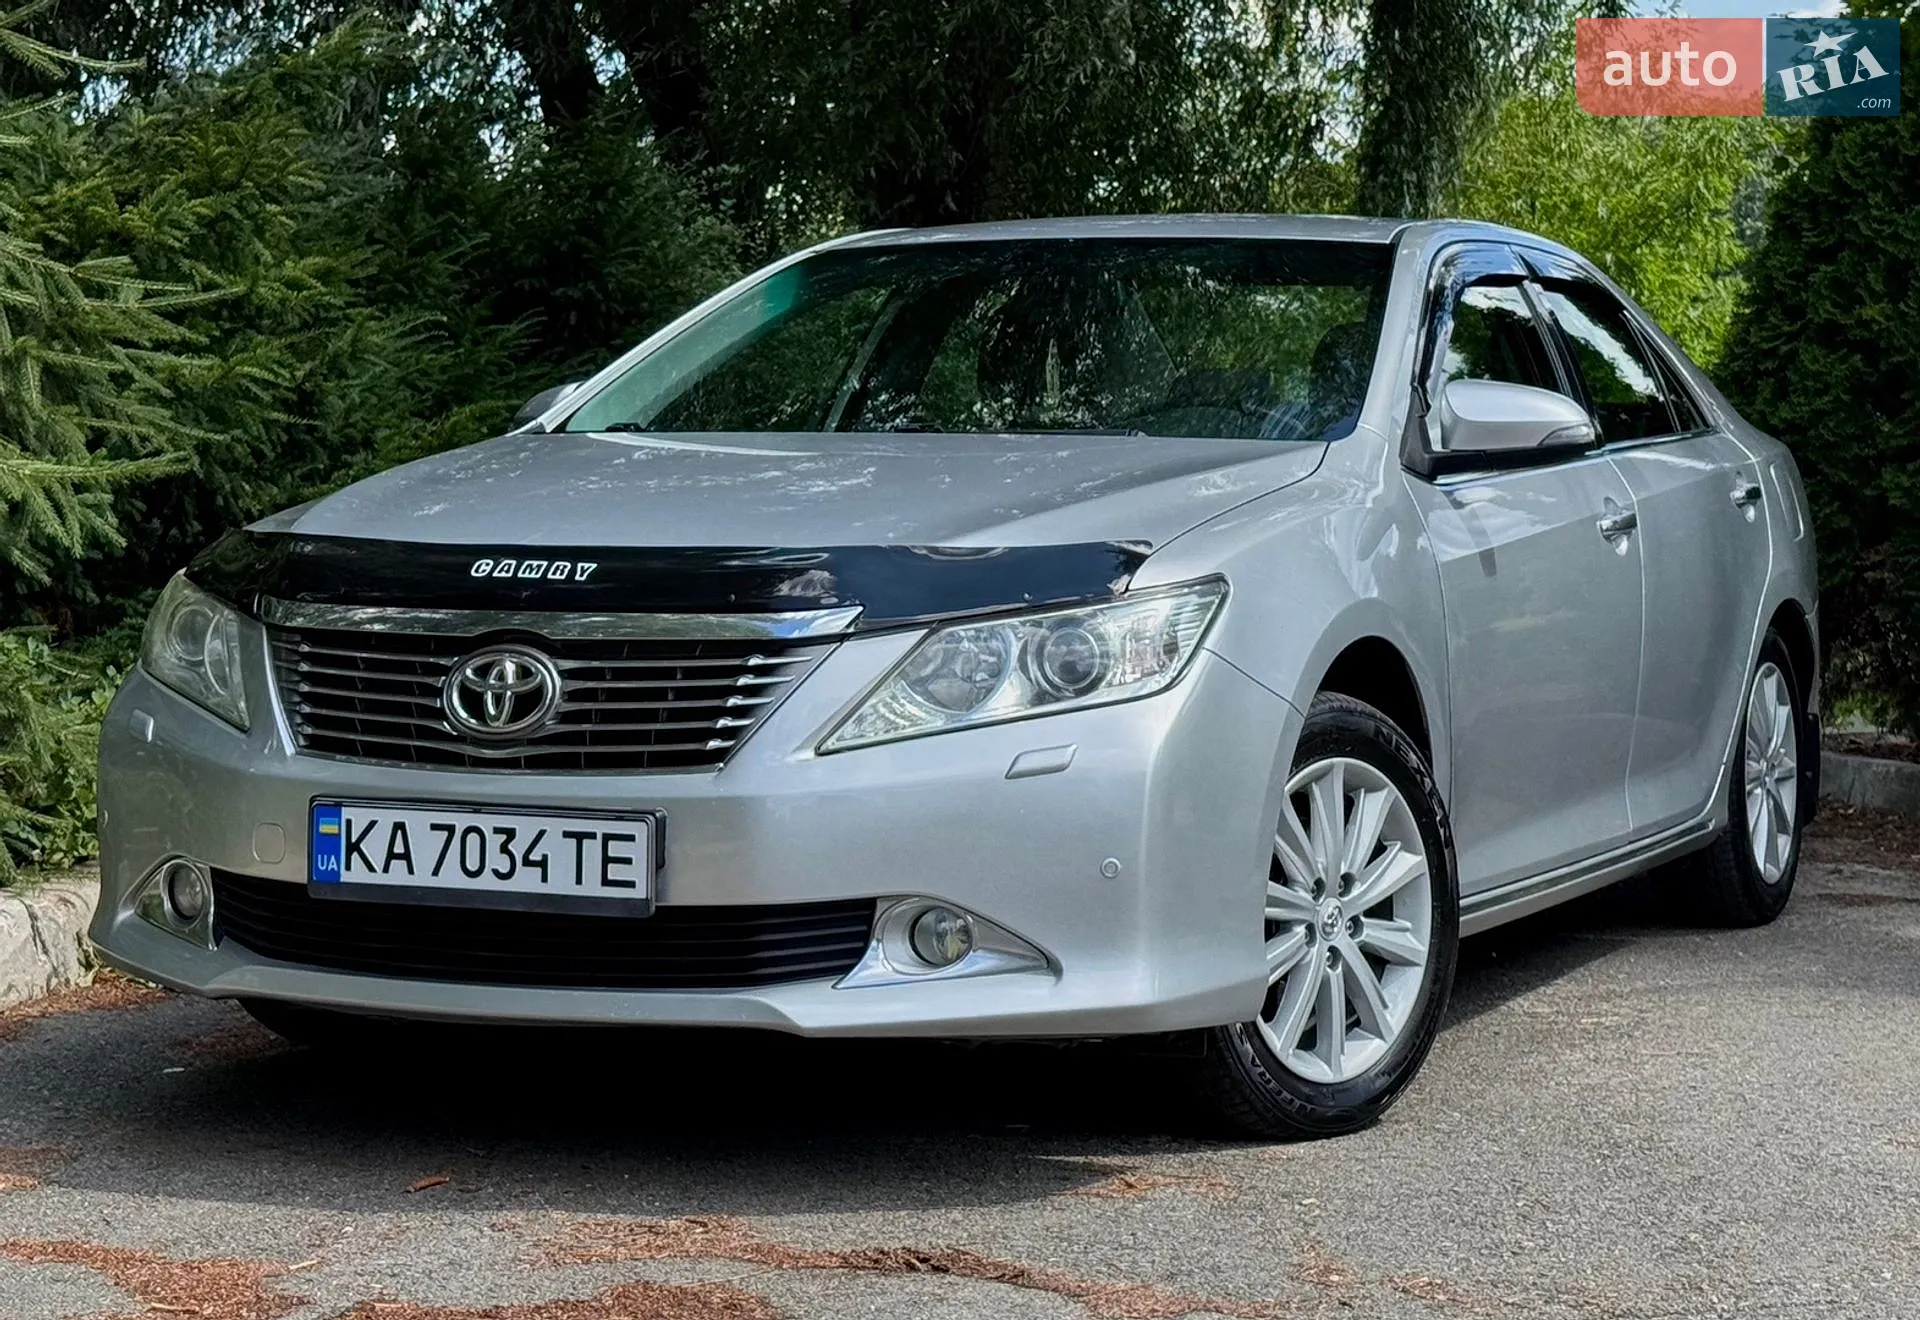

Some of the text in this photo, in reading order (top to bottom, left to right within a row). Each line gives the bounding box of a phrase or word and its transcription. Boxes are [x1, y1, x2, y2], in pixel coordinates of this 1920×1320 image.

[470, 559, 597, 581] CAMRY
[317, 854, 338, 871] UA
[344, 818, 636, 889] KA 7034 TE
